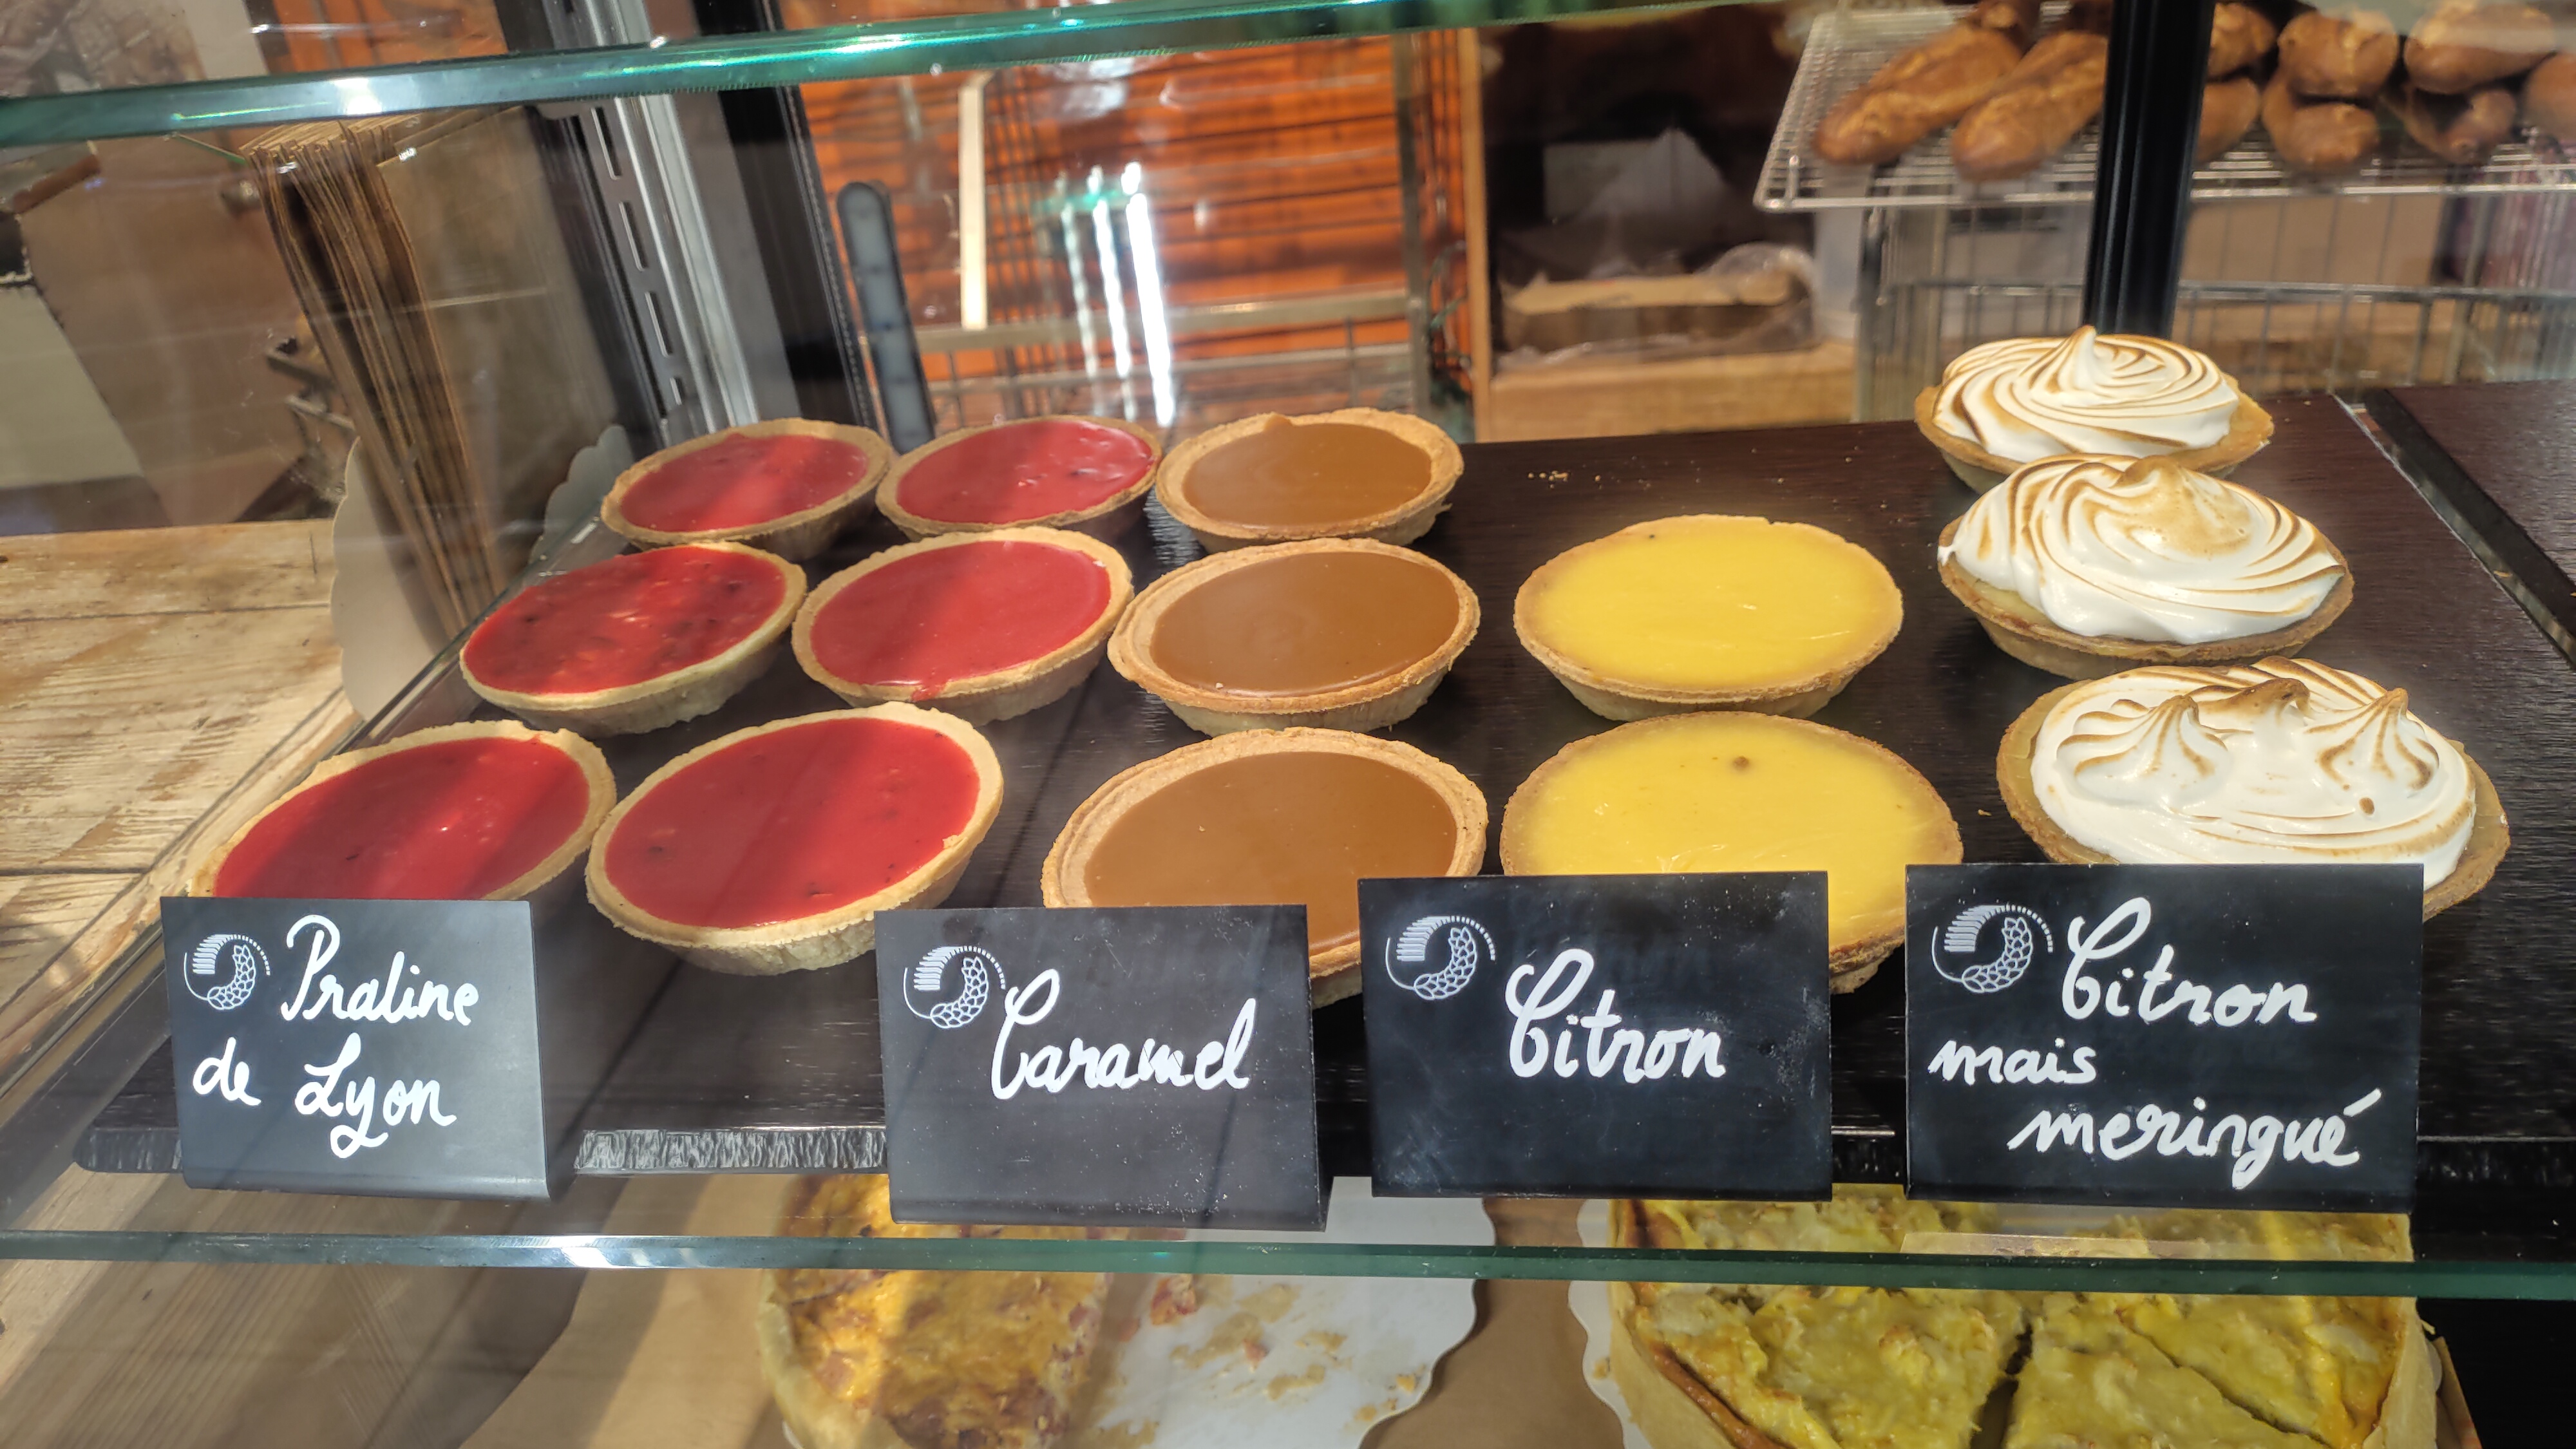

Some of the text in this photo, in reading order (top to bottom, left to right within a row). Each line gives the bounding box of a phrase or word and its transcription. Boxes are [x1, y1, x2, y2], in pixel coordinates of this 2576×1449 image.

[279, 913, 480, 1026] Praline
[1504, 947, 1727, 1084] Citron
[2061, 896, 2318, 1027] Citron
[191, 1032, 458, 1159] de Lyon
[990, 967, 1257, 1101] Caramel
[1927, 1038, 2097, 1086] mais
[2006, 1088, 2382, 1190] meringué
